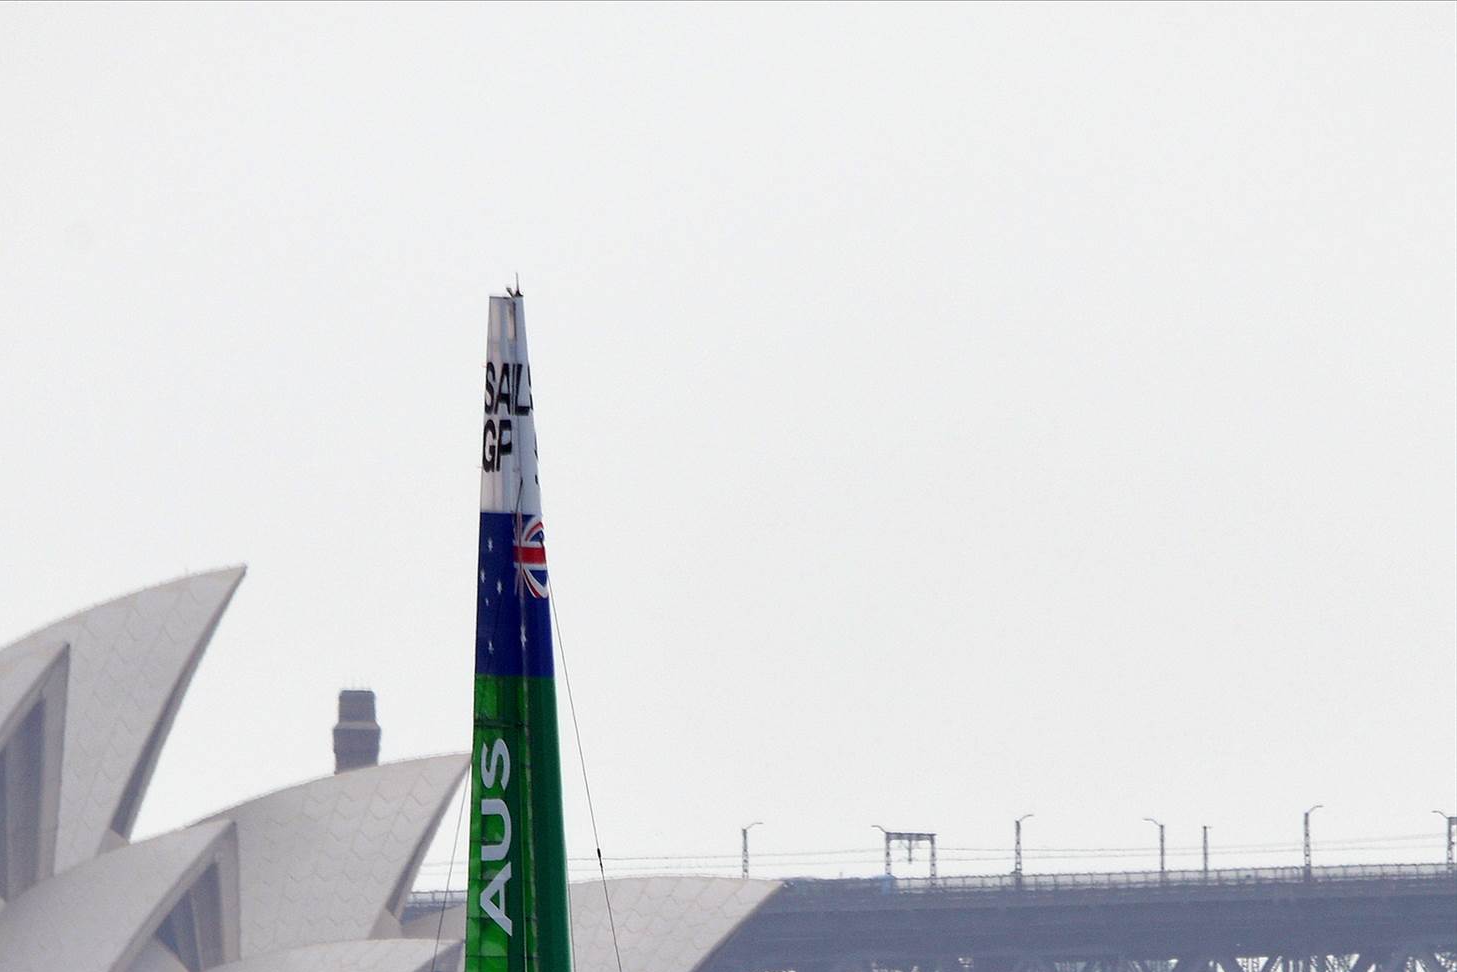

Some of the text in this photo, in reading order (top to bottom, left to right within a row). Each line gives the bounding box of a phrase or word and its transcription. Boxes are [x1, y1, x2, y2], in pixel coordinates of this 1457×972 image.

[484, 361, 530, 415] SAIL
[482, 419, 512, 473] GP
[480, 738, 512, 937] AUS
